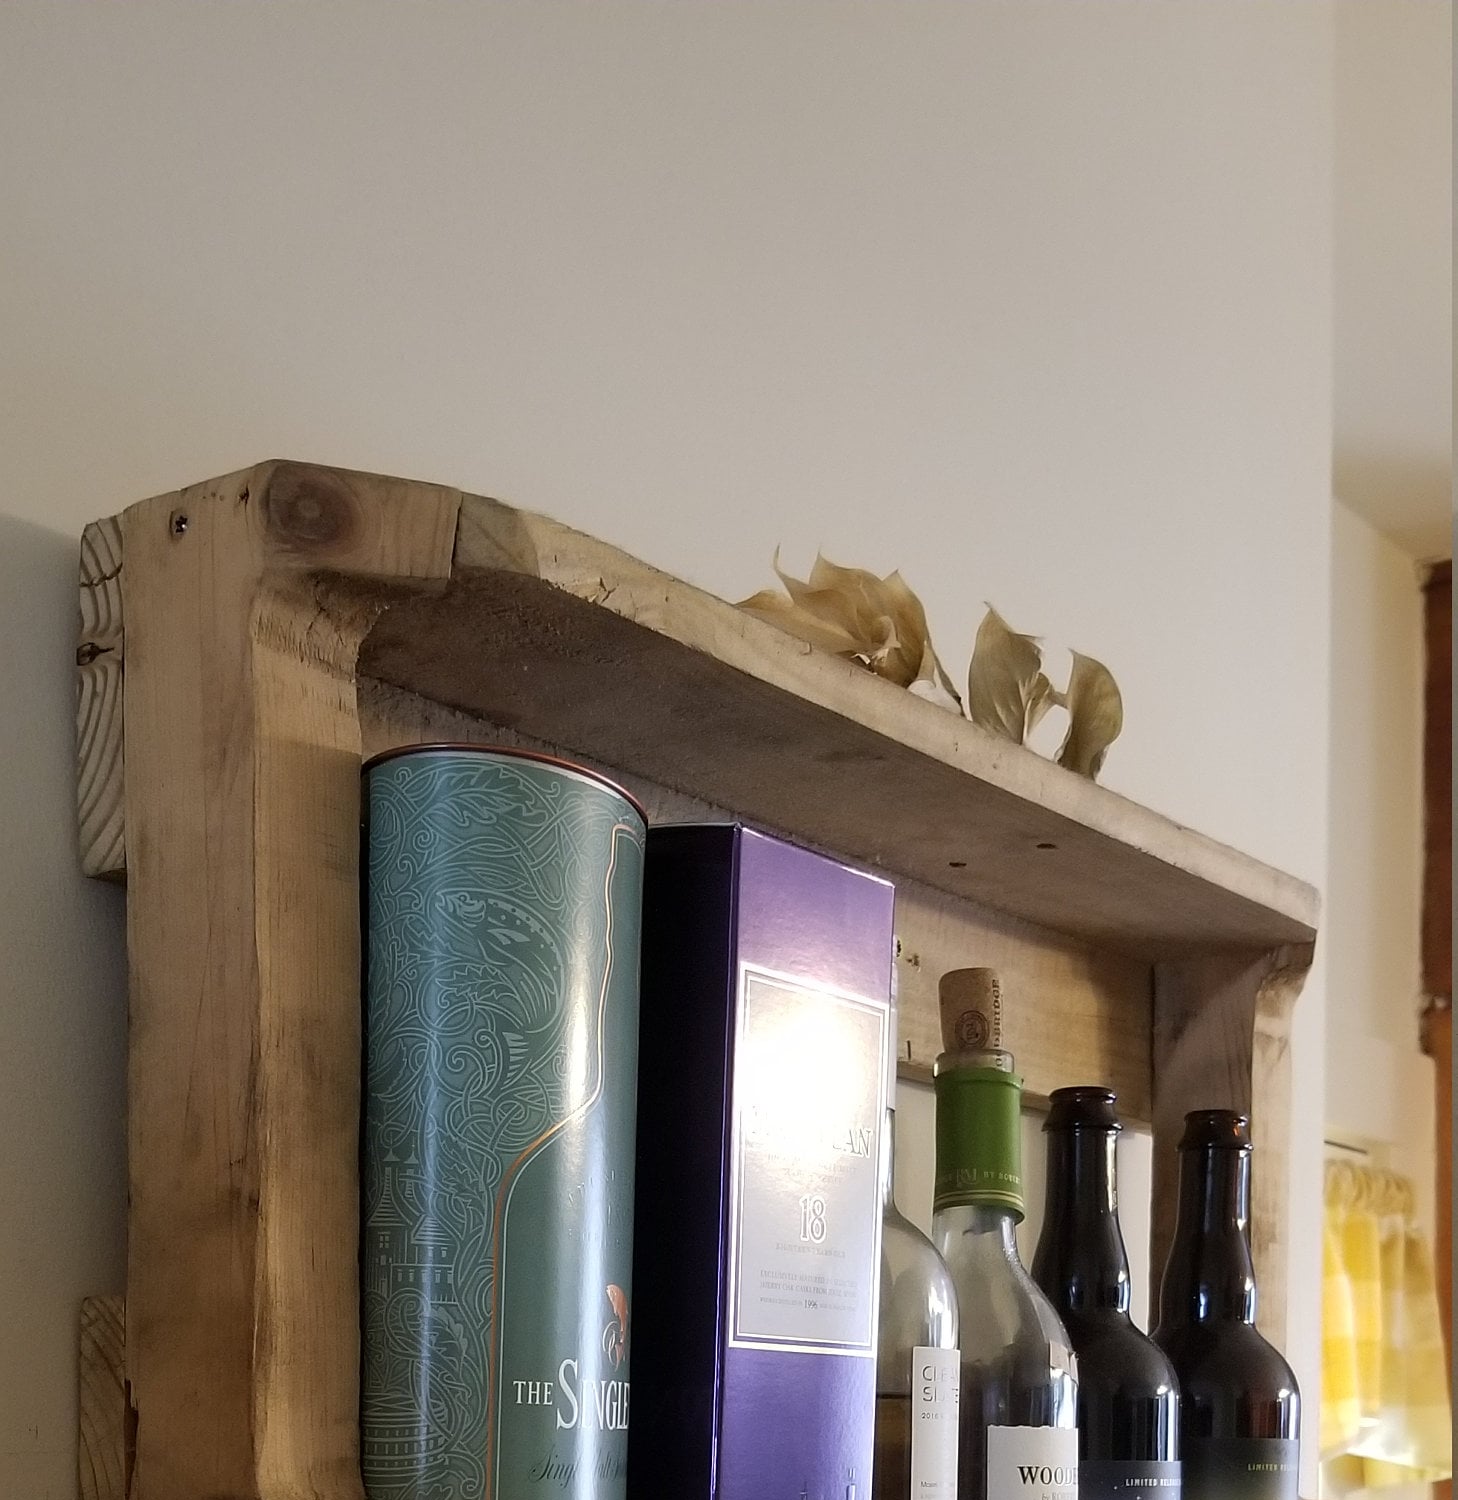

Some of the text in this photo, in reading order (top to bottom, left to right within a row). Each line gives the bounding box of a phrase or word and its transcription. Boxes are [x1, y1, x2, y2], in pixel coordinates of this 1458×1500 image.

[801, 1198, 825, 1240] 18
[513, 1380, 553, 1406] THE
[1125, 1478, 1158, 1487] LIMITED
